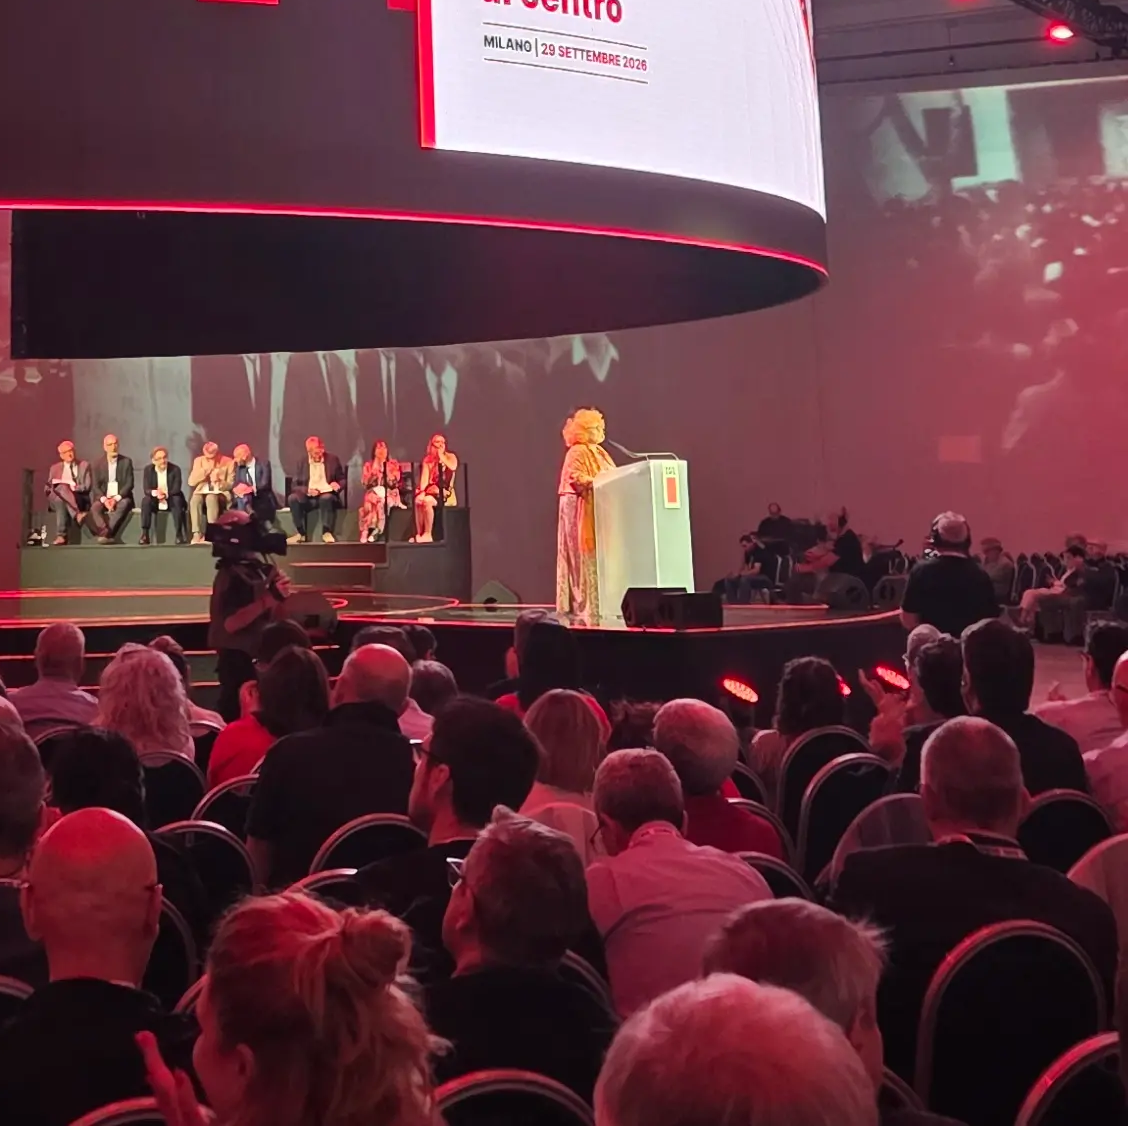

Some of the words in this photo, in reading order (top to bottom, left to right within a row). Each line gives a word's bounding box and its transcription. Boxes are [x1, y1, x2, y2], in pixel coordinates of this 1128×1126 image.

[483, 34, 532, 53] MILANO
[541, 42, 556, 57] 29
[558, 45, 621, 67] SETTEMBRE
[622, 55, 648, 72] 2026
